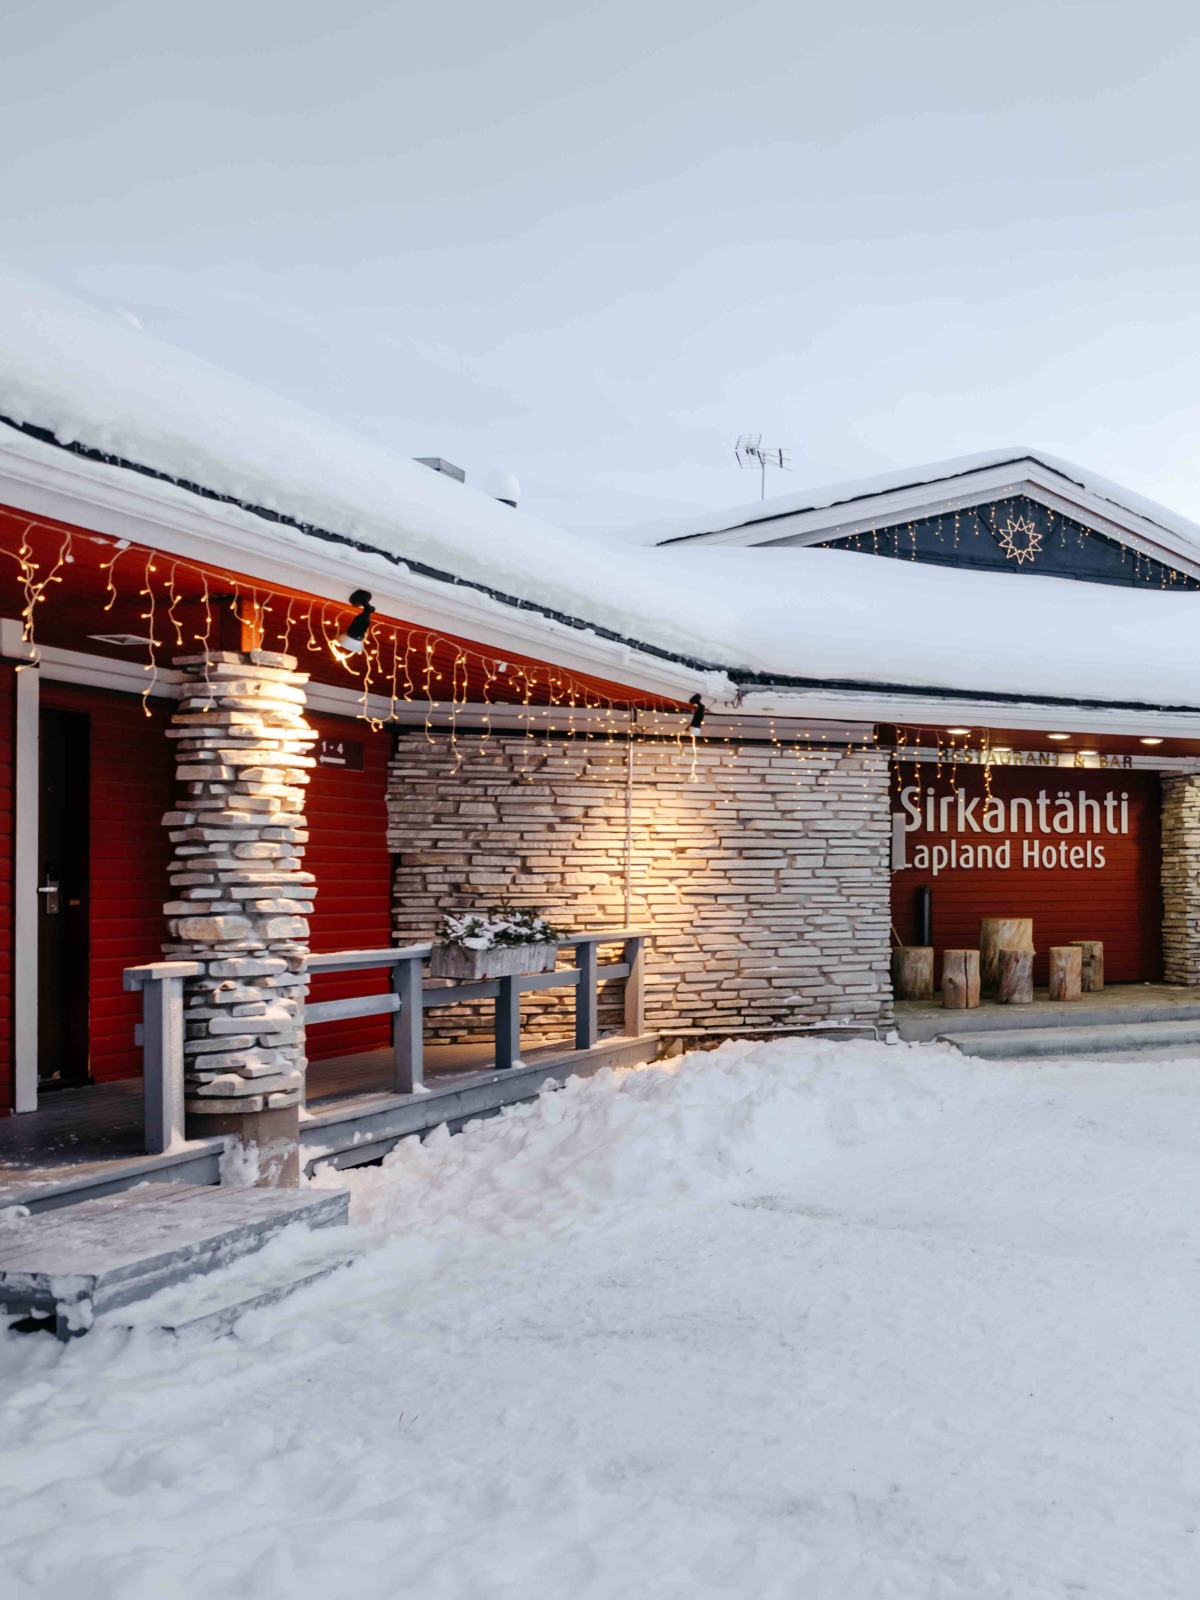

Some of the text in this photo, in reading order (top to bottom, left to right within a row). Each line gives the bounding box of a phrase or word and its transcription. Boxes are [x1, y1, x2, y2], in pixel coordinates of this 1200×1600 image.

[938, 748, 1132, 769] RESTAURANT & BAR
[901, 786, 1129, 833] Sirkantähti
[903, 839, 1106, 876] apland Hotels
